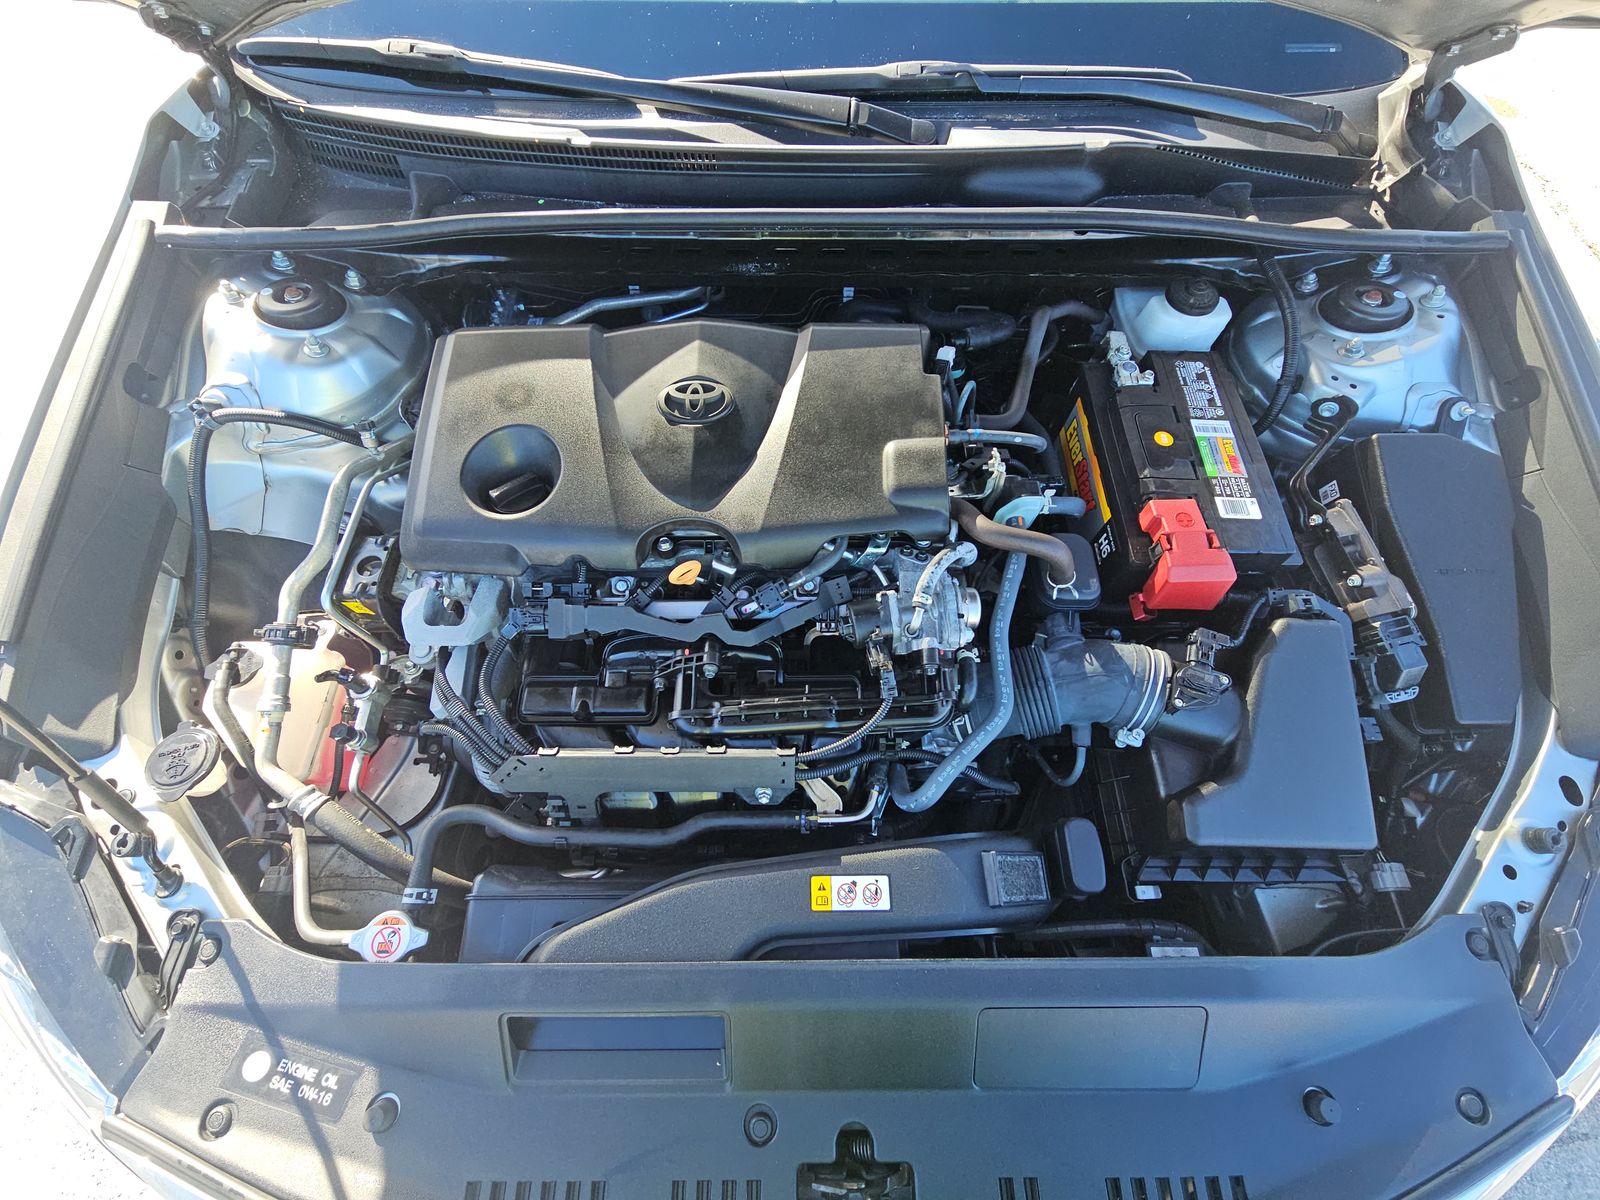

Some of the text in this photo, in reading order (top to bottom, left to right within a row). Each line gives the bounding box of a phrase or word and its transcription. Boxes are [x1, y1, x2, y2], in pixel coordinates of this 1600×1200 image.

[1098, 533, 1111, 558] H6
[276, 1058, 339, 1090] ENGINE OIL
[269, 1075, 333, 1106] SAE 0W-16
